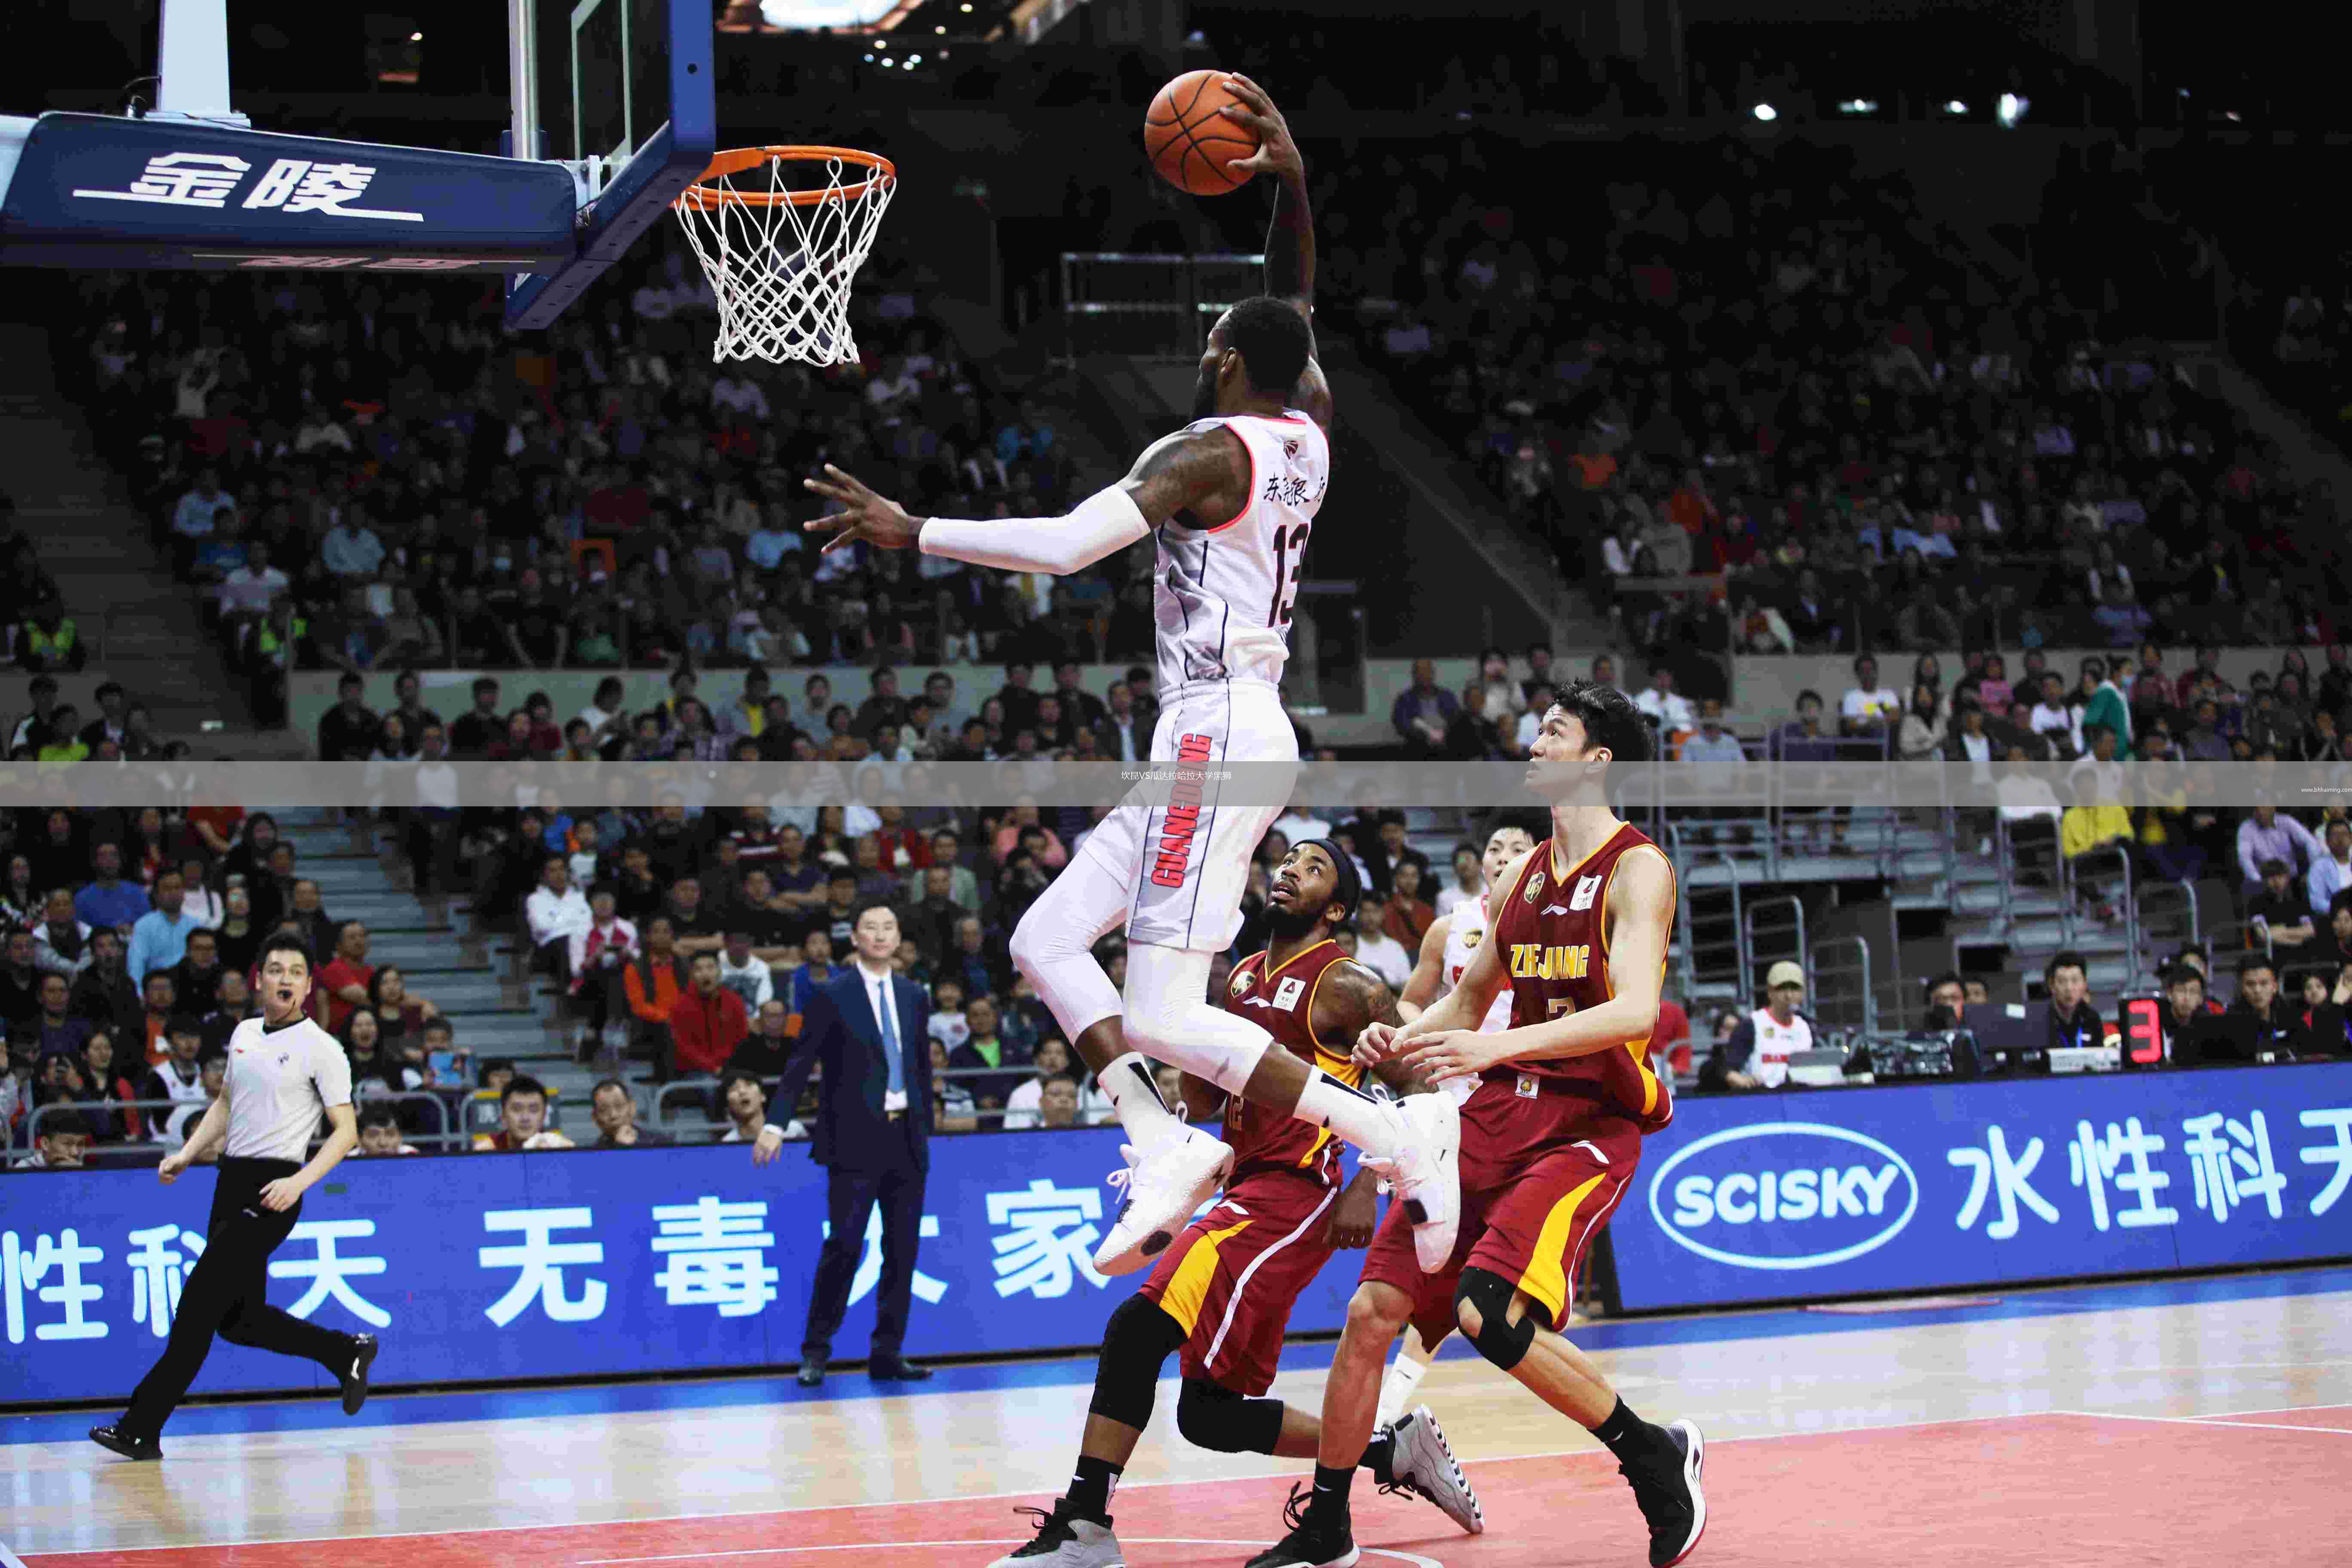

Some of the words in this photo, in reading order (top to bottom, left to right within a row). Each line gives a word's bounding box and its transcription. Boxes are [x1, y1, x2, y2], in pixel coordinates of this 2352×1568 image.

[129, 151, 378, 215] 金陵
[1151, 733, 1212, 888] GUANGDONG
[2127, 999, 2162, 1063] 3
[1672, 1163, 1900, 1228] SCISKY
